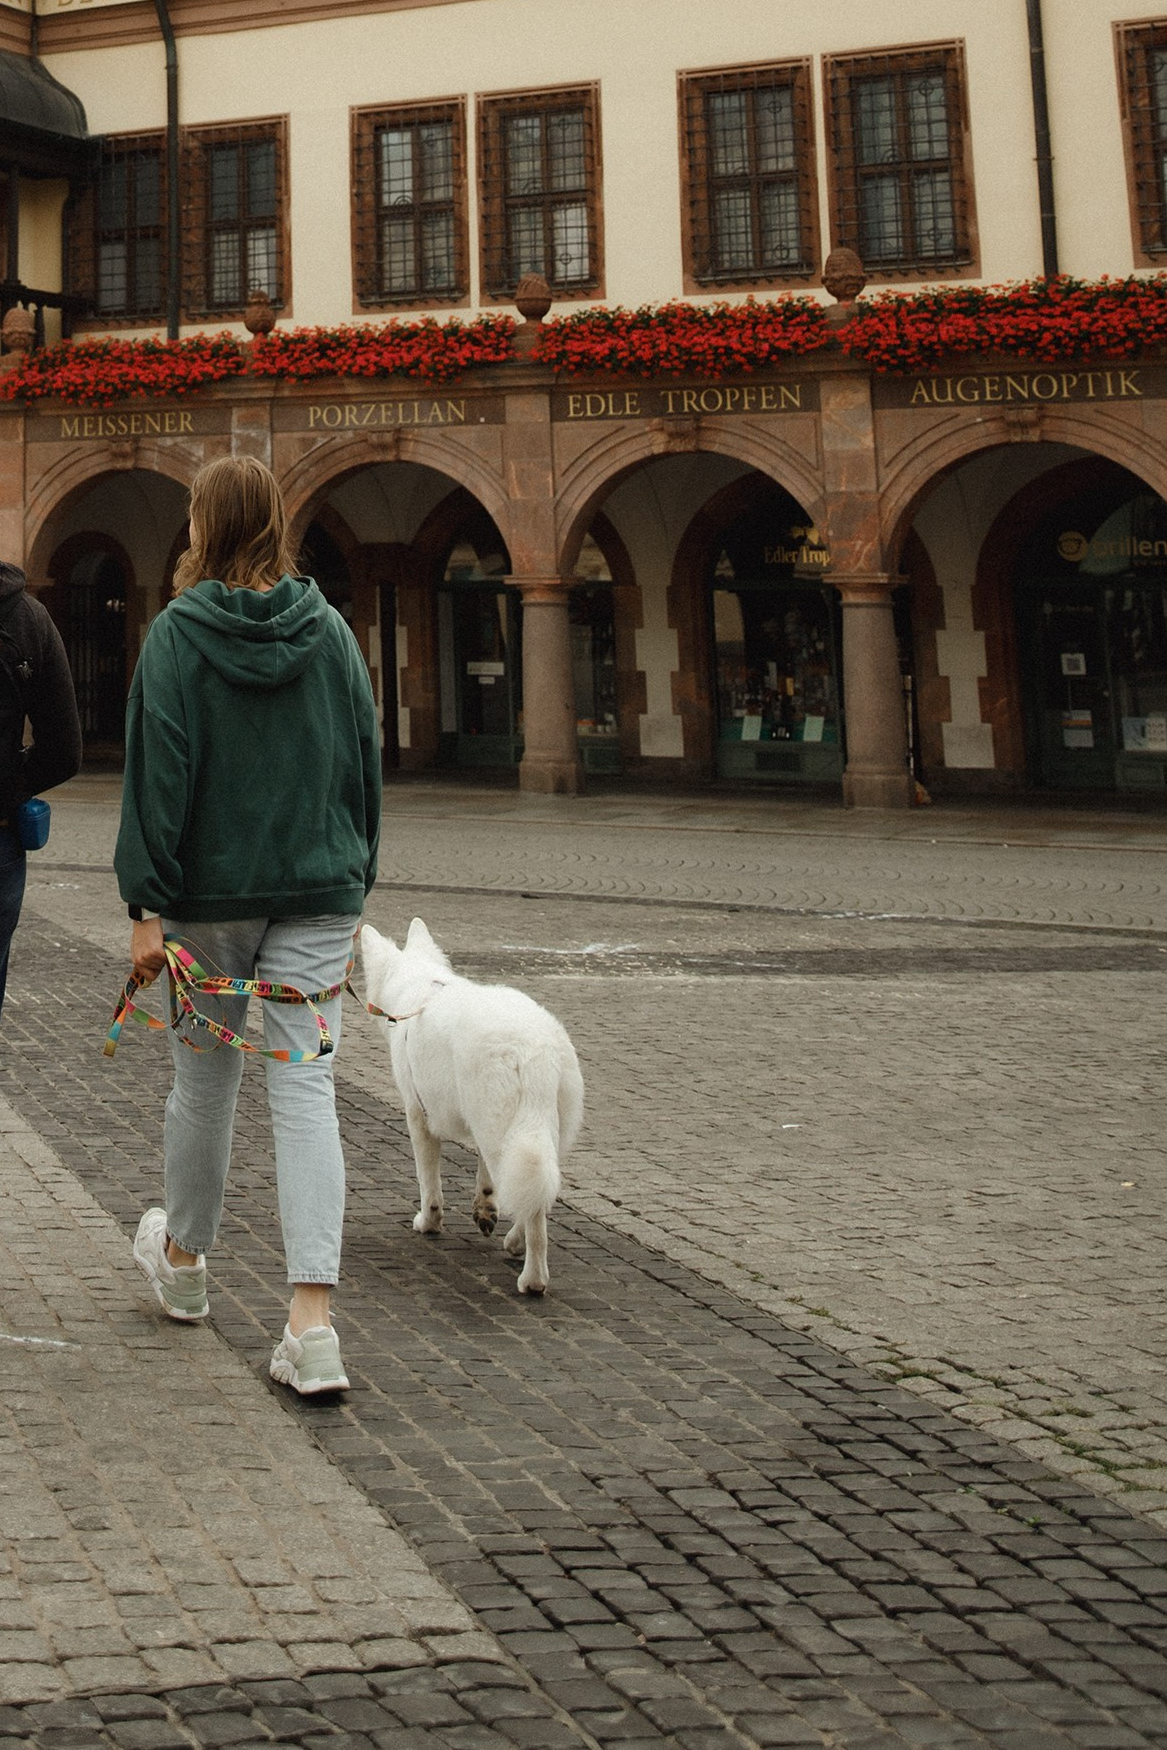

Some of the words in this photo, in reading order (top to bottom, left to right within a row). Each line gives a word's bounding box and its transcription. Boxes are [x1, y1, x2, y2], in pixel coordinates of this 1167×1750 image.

[567, 393, 641, 418] EDLE
[660, 384, 802, 414] TROPFEN
[910, 370, 1143, 405] AUGENOPTIK
[60, 411, 194, 438] MEISSENER
[308, 400, 466, 428] PORZELLAN
[763, 545, 797, 564] Edler
